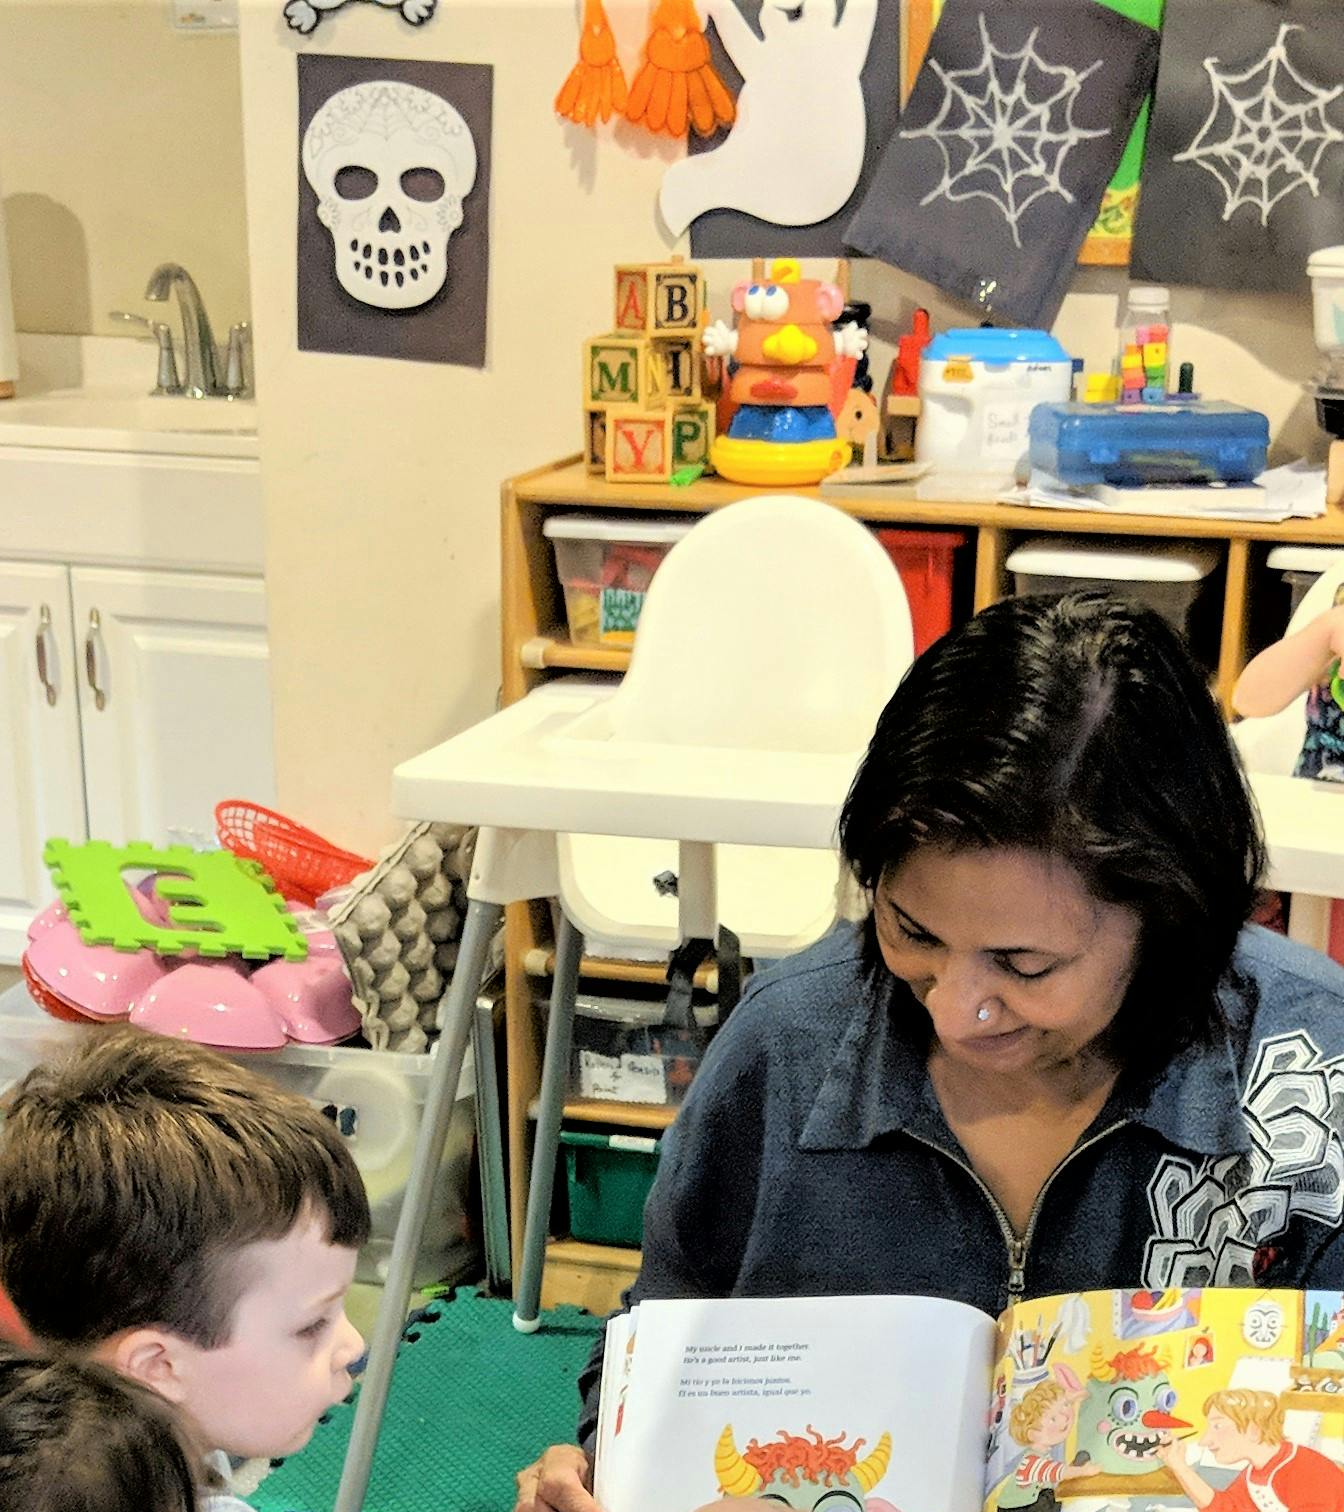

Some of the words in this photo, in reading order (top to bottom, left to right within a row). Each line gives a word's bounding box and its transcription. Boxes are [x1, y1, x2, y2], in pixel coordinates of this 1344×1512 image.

[619, 281, 643, 327] A
[664, 285, 689, 322] B
[598, 361, 631, 393] M
[618, 429, 655, 471] Y
[674, 421, 701, 461] P
[707, 1356, 726, 1364] good
